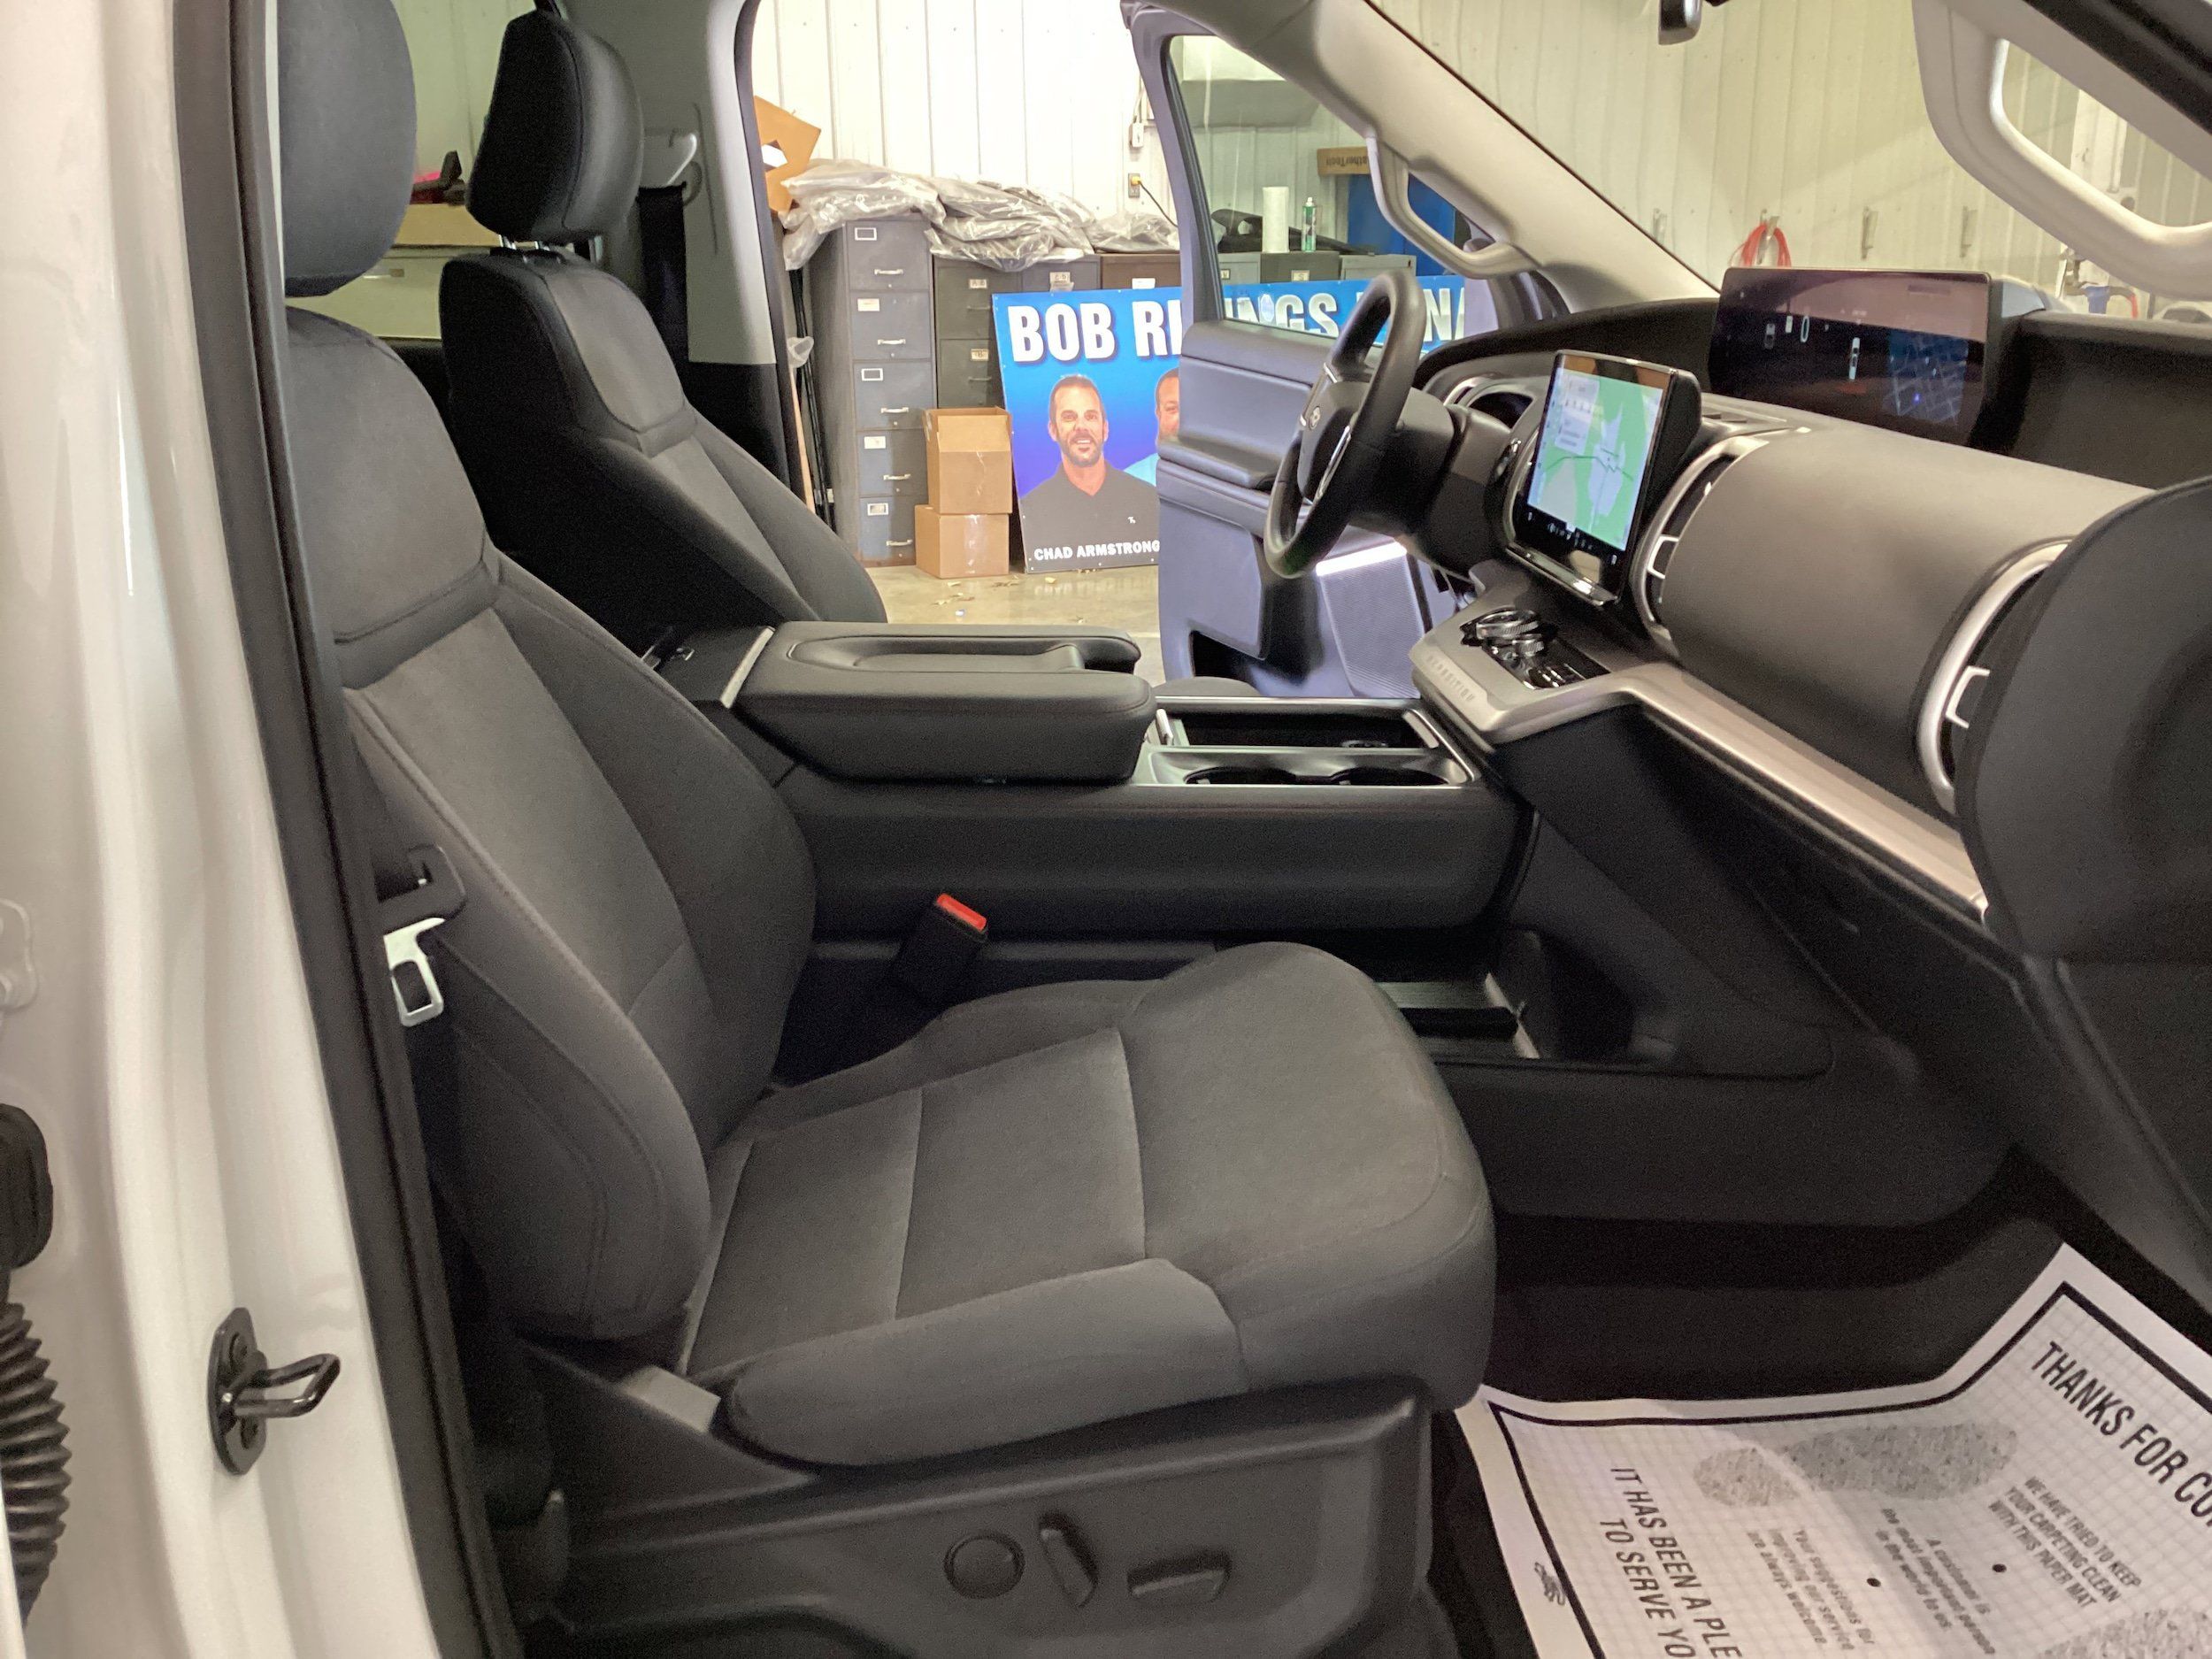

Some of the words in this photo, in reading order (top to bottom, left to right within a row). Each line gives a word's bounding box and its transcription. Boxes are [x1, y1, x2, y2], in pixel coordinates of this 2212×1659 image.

[1008, 303, 1115, 362] BOB
[1033, 547, 1073, 561] CHAD
[1076, 540, 1160, 558] ARMSTRONG
[2032, 1340, 2135, 1436] THANKS
[2119, 1424, 2189, 1485] FOR
[2175, 1472, 2212, 1527] CO
[1610, 1469, 1642, 1484] IT
[1600, 1518, 1634, 1543] TO
[1623, 1491, 1668, 1530] HAS
[2024, 1477, 2046, 1494] WE
[2039, 1492, 2071, 1519] HAVE
[2063, 1516, 2100, 1548] TRIED
[2094, 1545, 2115, 1563] TO
[2108, 1561, 2142, 1586] KEEP
[1648, 1536, 1701, 1588] BEEN
[2006, 1486, 2035, 1515] YOUR
[2029, 1512, 2088, 1569] CARPETING
[2082, 1566, 2122, 1602] CLEAN
[2013, 1525, 2042, 1551] THIS
[2035, 1549, 2073, 1585] PAPER
[2066, 1582, 2097, 1608] MAT
[1616, 1551, 1677, 1620] SERVE
[1681, 1596, 1712, 1610] A
